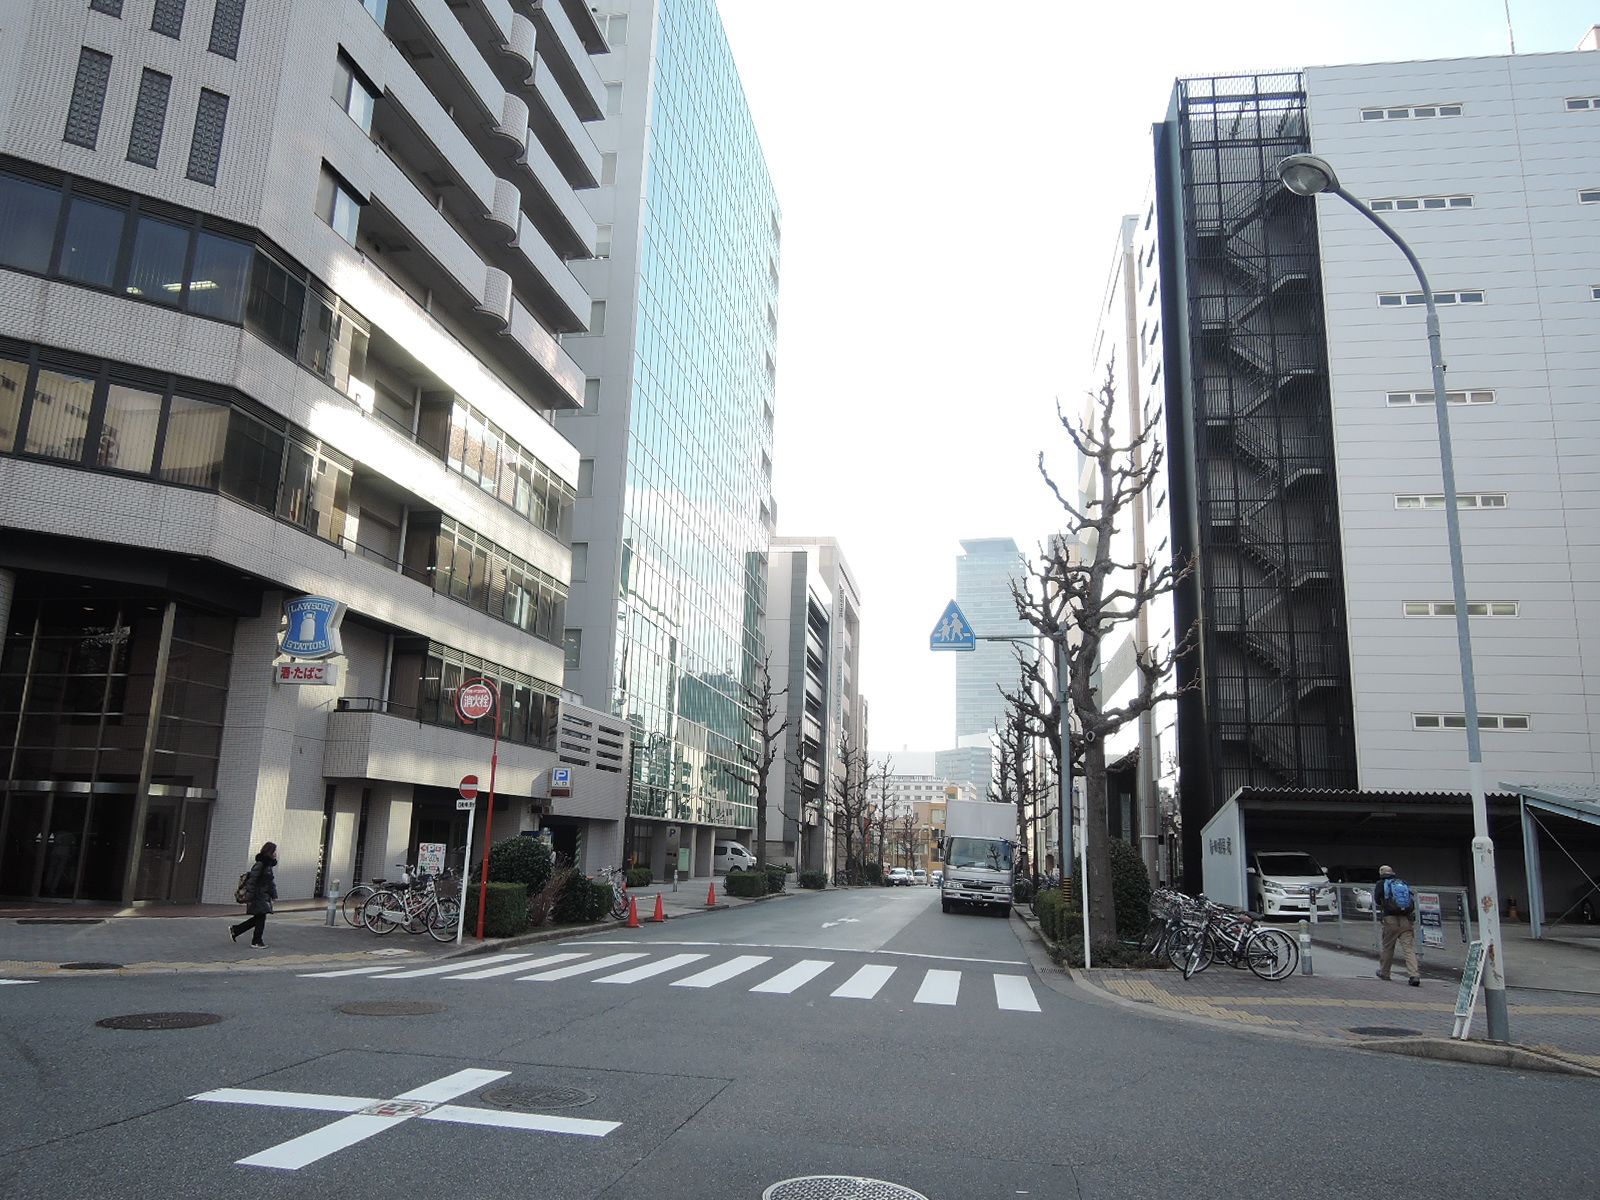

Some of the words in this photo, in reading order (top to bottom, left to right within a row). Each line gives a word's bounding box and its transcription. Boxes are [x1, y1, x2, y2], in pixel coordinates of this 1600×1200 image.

[290, 602, 331, 613] LAWSON
[286, 640, 326, 651] STATION
[464, 694, 490, 708] 消火栓
[555, 770, 567, 781] P
[669, 828, 676, 838] P
